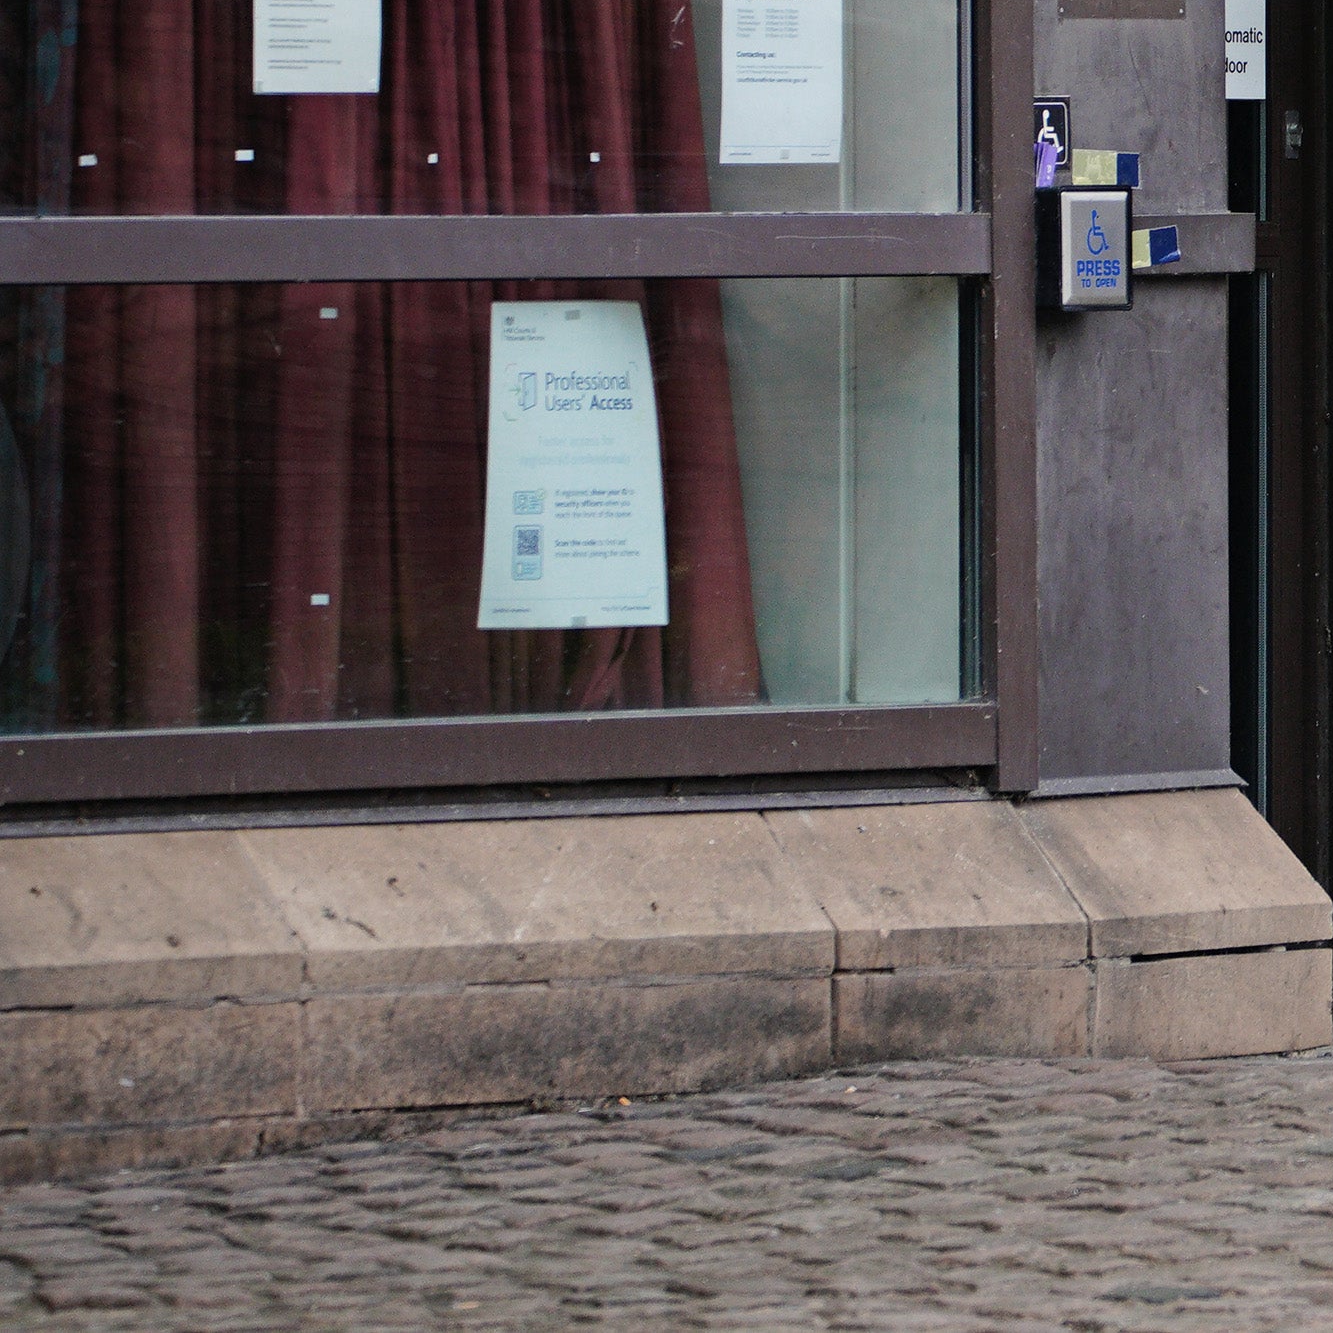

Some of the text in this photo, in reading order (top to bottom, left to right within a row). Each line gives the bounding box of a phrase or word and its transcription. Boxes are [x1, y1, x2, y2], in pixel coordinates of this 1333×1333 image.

[1224, 27, 1264, 44] omatic
[1076, 259, 1121, 276] PRESS
[1081, 278, 1117, 288] TO OPEN
[545, 371, 630, 391] Professional
[589, 394, 633, 411] Access
